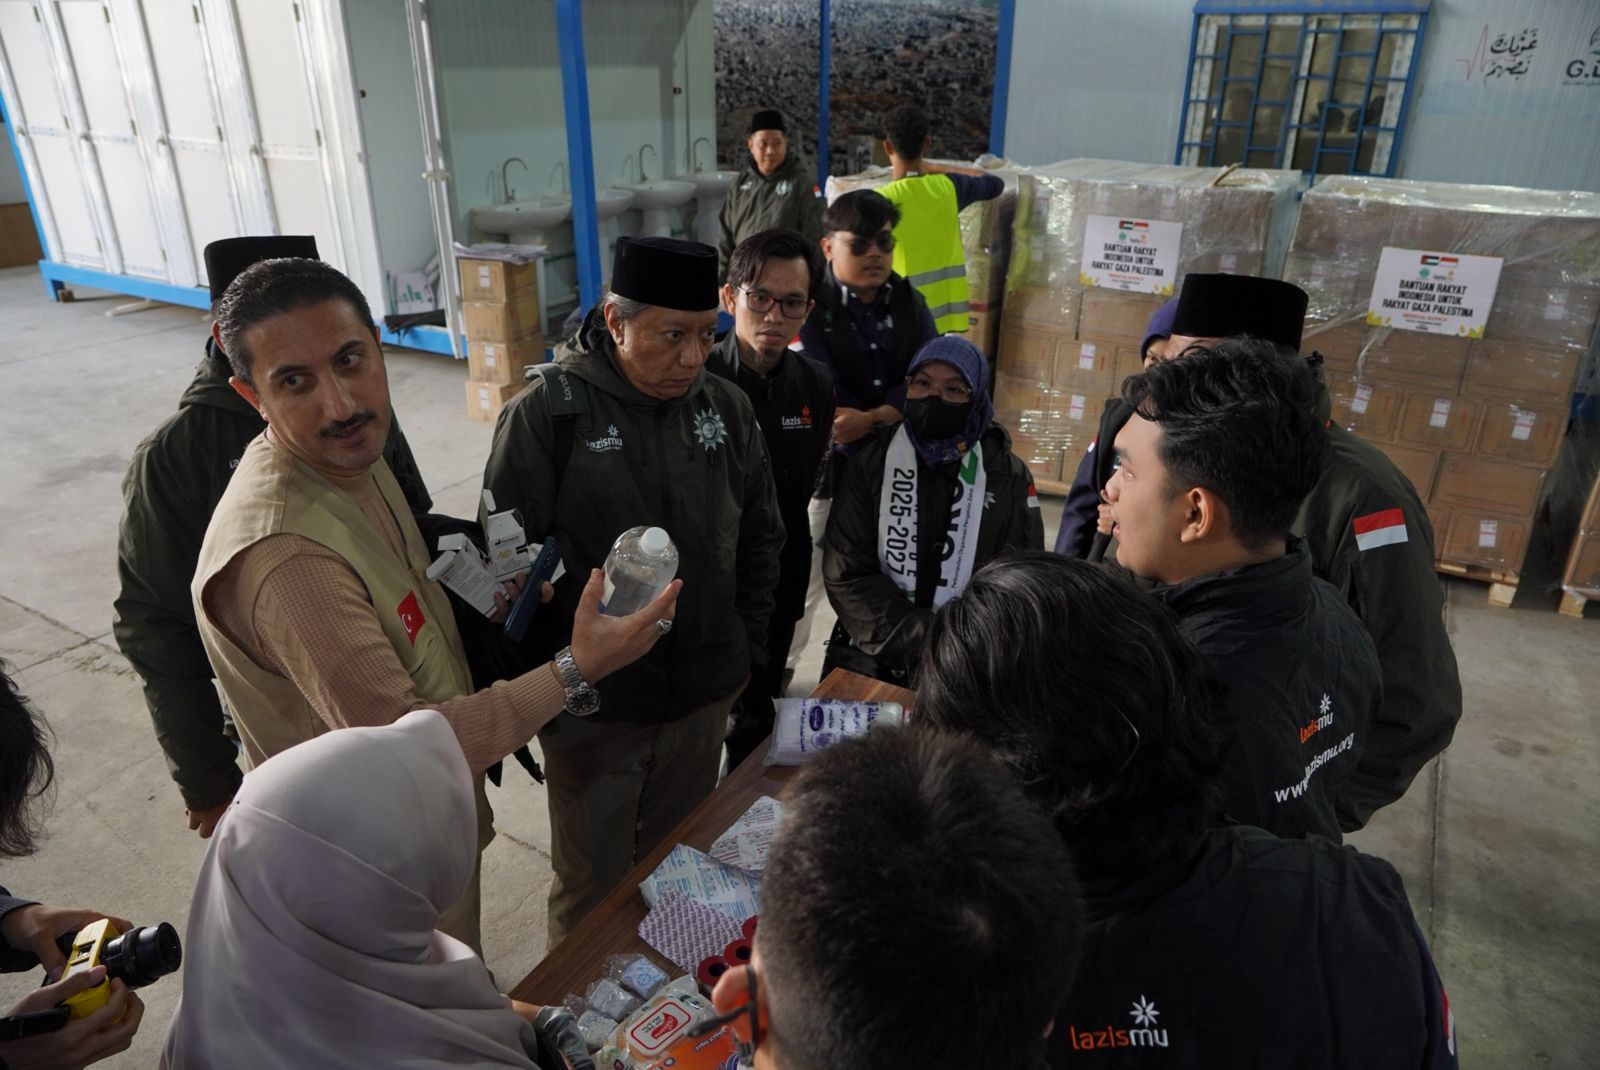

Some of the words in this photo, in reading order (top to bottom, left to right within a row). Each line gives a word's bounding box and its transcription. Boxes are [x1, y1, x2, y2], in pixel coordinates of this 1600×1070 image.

[1104, 243, 1131, 254] BANTUAN
[1133, 246, 1157, 256] RAKYAT
[1104, 253, 1133, 263] INDONESIA
[1135, 256, 1154, 265] UNTUK
[1092, 261, 1114, 271] RAKYAT
[1115, 263, 1130, 273] GAZA
[1131, 265, 1164, 276] PALESTINA
[1399, 280, 1435, 292] BANTUAN
[1436, 284, 1467, 295] RAKYAT
[1398, 291, 1436, 302] INDONESIA
[1438, 295, 1463, 305] UNTUK
[1382, 299, 1410, 309] RAKYAT
[1412, 302, 1432, 313] GAZA
[1433, 304, 1474, 317] PALESTINA
[586, 437, 623, 449] lazismu
[885, 467, 915, 576] 2025-2027
[1300, 712, 1334, 744] lazismu
[1069, 1026, 1168, 1050] lazismu
